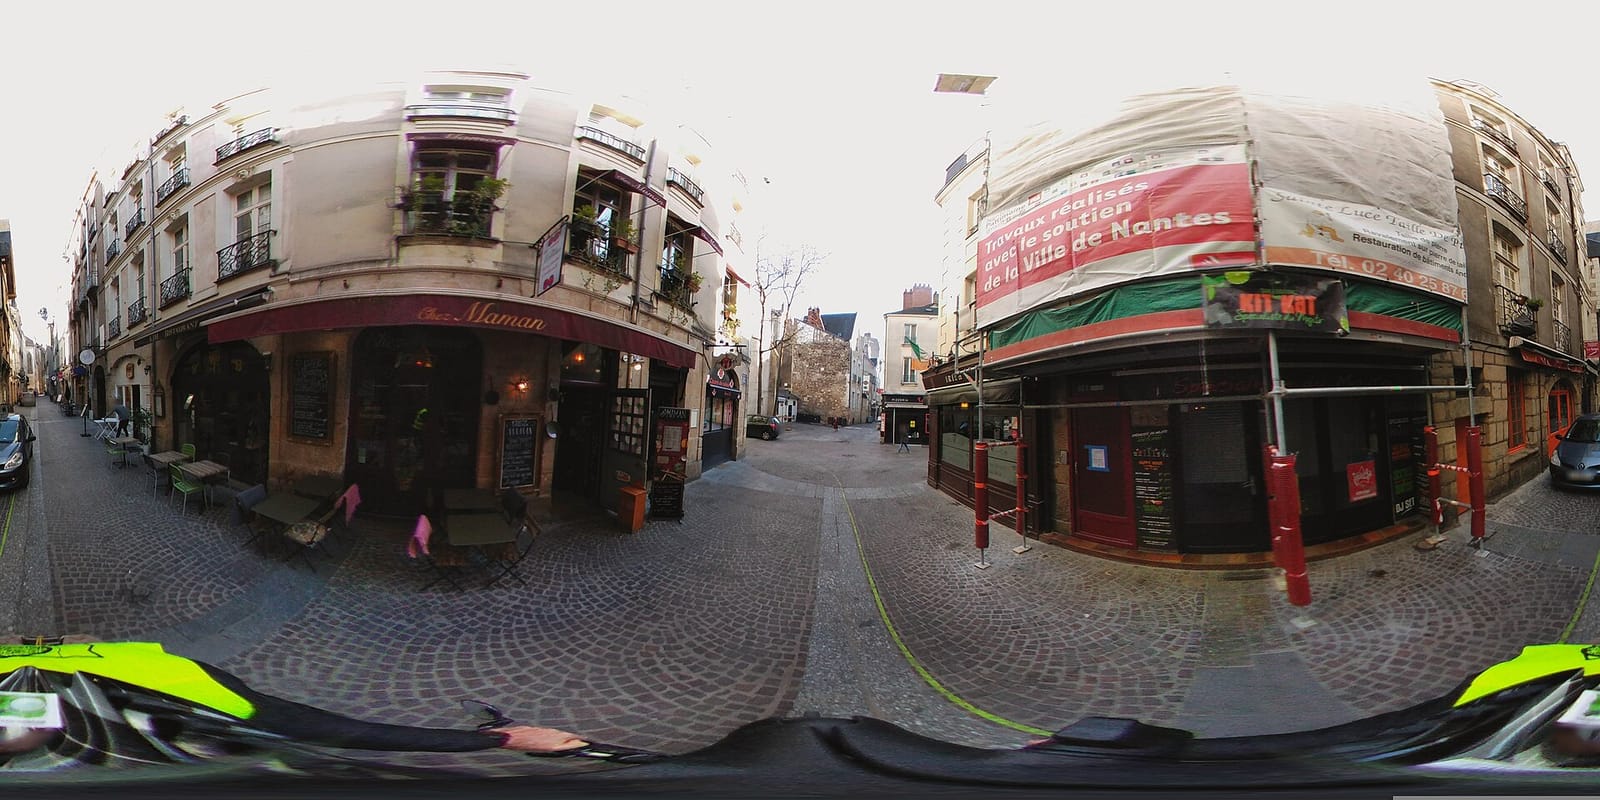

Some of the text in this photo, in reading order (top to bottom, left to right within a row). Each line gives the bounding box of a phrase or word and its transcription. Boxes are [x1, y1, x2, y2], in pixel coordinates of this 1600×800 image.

[985, 182, 1149, 255] Travaux réalisés
[1338, 206, 1382, 220] Luce
[1386, 214, 1426, 235] Taille
[985, 200, 1132, 271] avec le soutien
[1352, 233, 1412, 256] Restauration
[1412, 252, 1422, 260] de
[1432, 241, 1448, 253] pierre
[984, 211, 1232, 292] de la Ville de Nantes
[1418, 244, 1429, 253] sur
[1430, 250, 1448, 262] pierre
[1449, 257, 1457, 265] de
[1311, 250, 1354, 271] Tél.
[1362, 260, 1388, 276] 02
[1393, 267, 1414, 283] 40
[1419, 275, 1438, 289] 25
[1441, 282, 1458, 296] 87
[418, 301, 546, 330] Chez Maman
[1239, 293, 1272, 313] KIT
[1395, 502, 1405, 514] DJ
